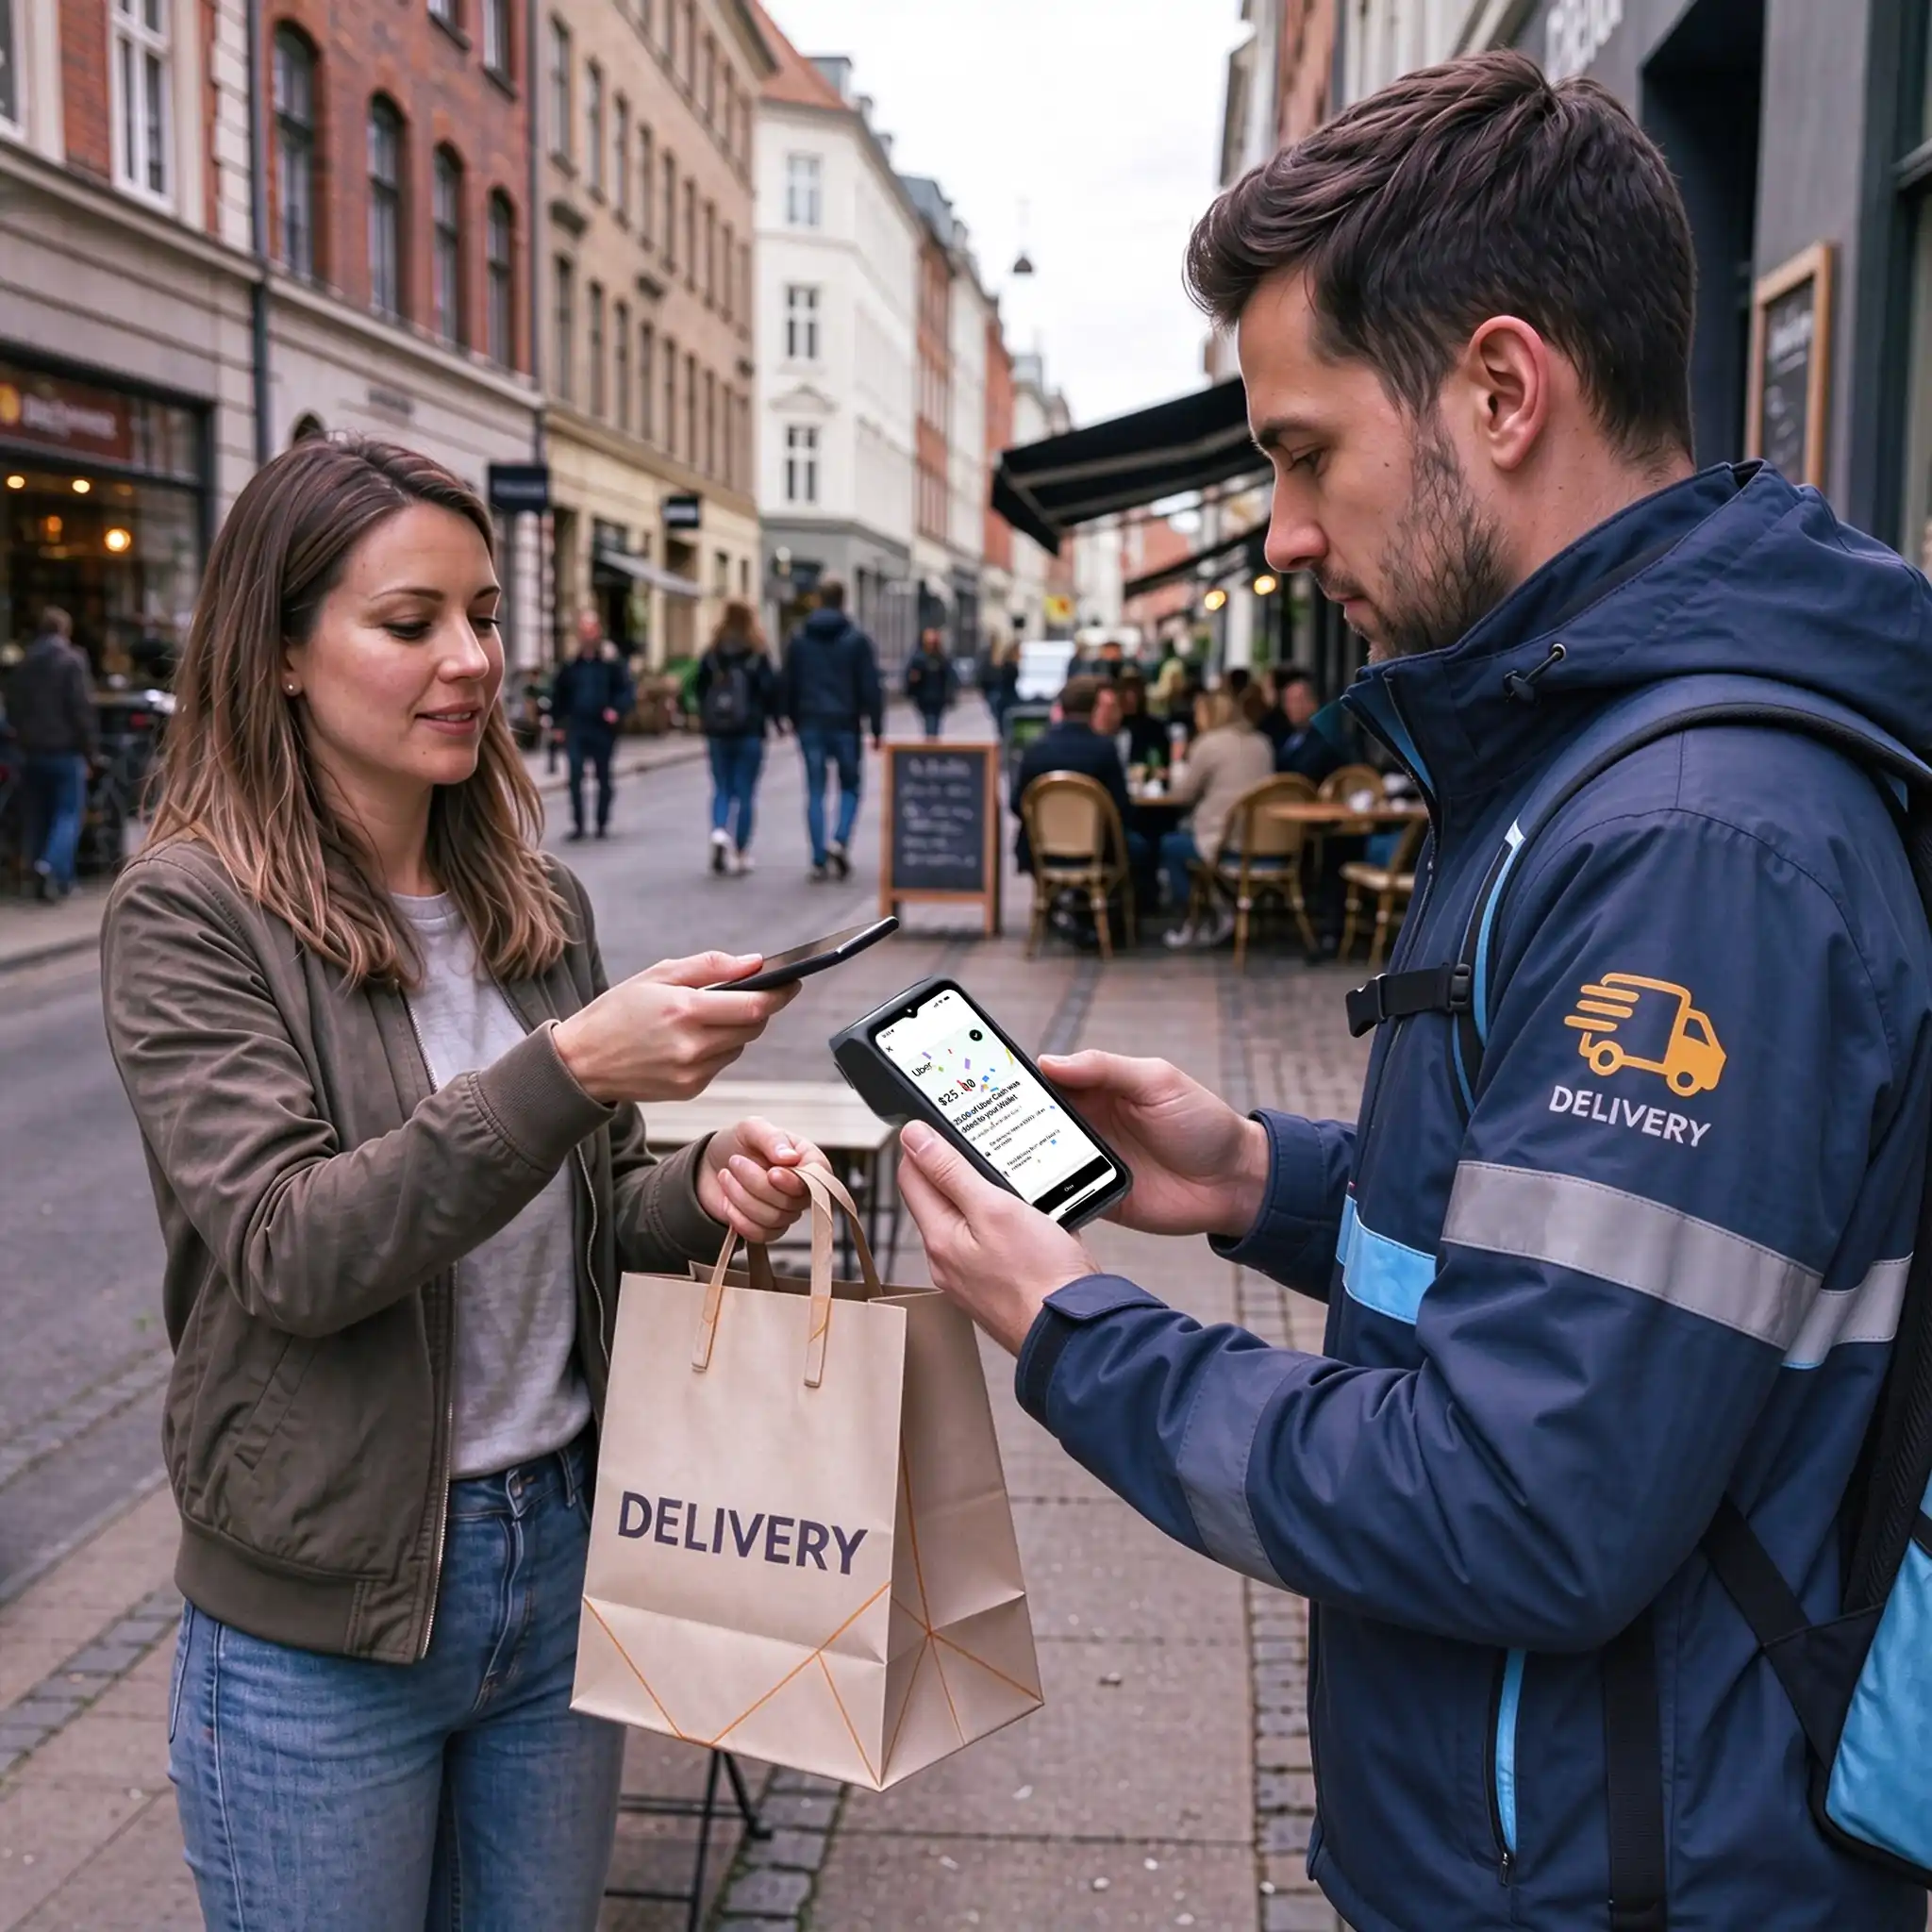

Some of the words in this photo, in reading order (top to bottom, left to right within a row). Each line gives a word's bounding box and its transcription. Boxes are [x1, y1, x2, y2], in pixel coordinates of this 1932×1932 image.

[911, 1061, 932, 1077] Uber
[938, 1078, 976, 1106] $25.00
[970, 1106, 979, 1116] of
[977, 1097, 993, 1110] Uber
[991, 1088, 1008, 1102] Cash
[1006, 1081, 1021, 1093] was
[976, 1114, 986, 1124] to
[984, 1106, 1000, 1120] your
[998, 1093, 1019, 1110] Wallet
[1549, 1085, 1711, 1147] DELIVERY
[618, 1491, 868, 1575] DELIVERY
